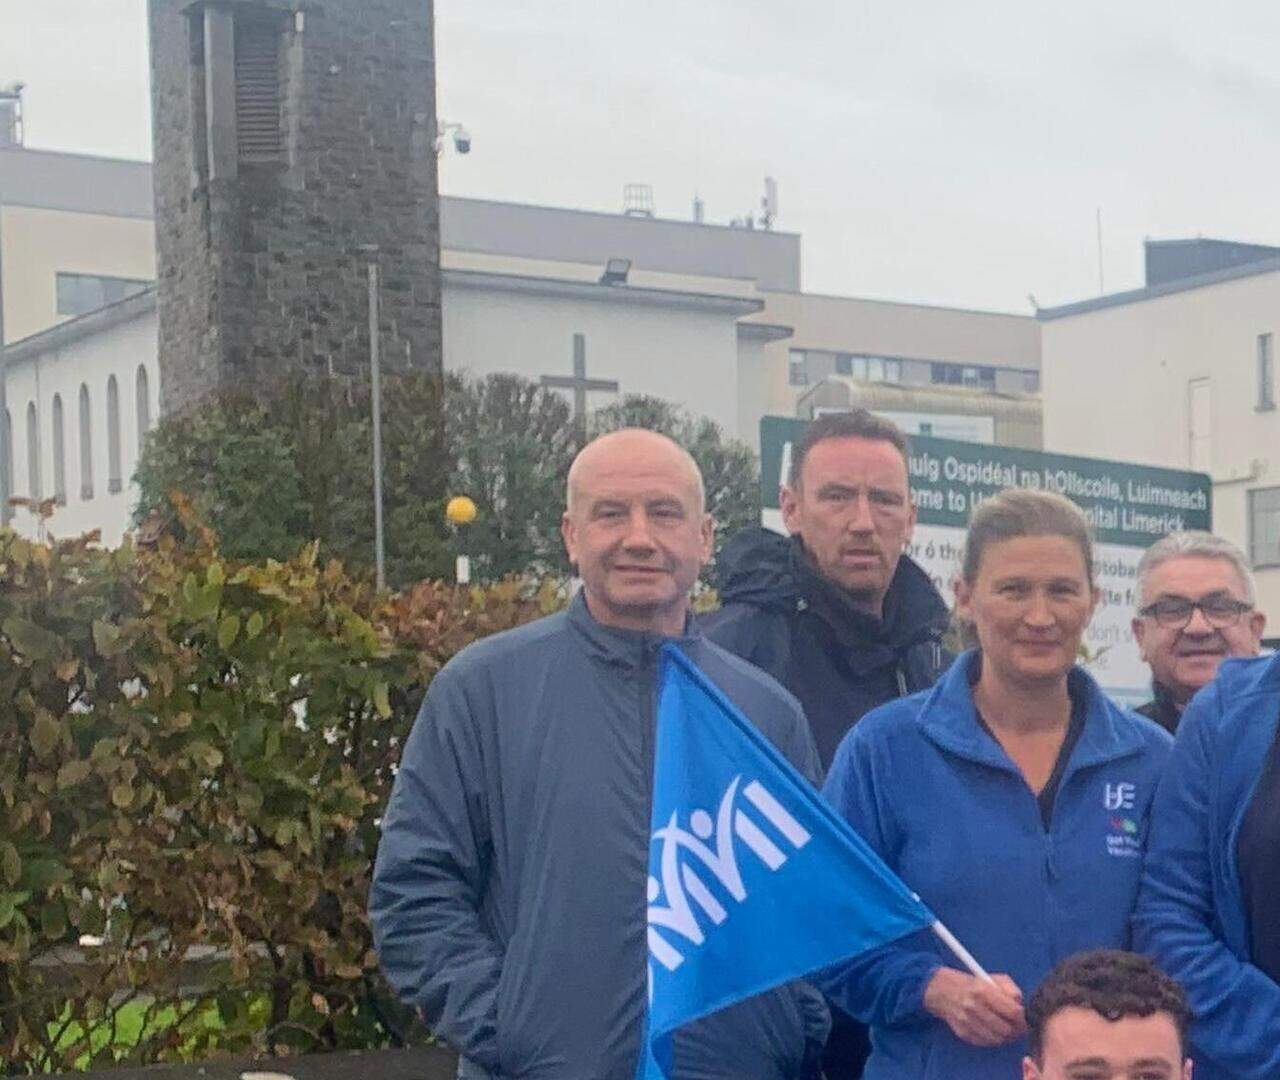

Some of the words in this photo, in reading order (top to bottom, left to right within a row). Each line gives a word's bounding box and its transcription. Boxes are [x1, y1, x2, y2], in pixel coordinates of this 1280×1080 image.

[948, 489, 966, 512] to
[1122, 508, 1185, 533] Limerick
[1129, 480, 1207, 510] Luimneach
